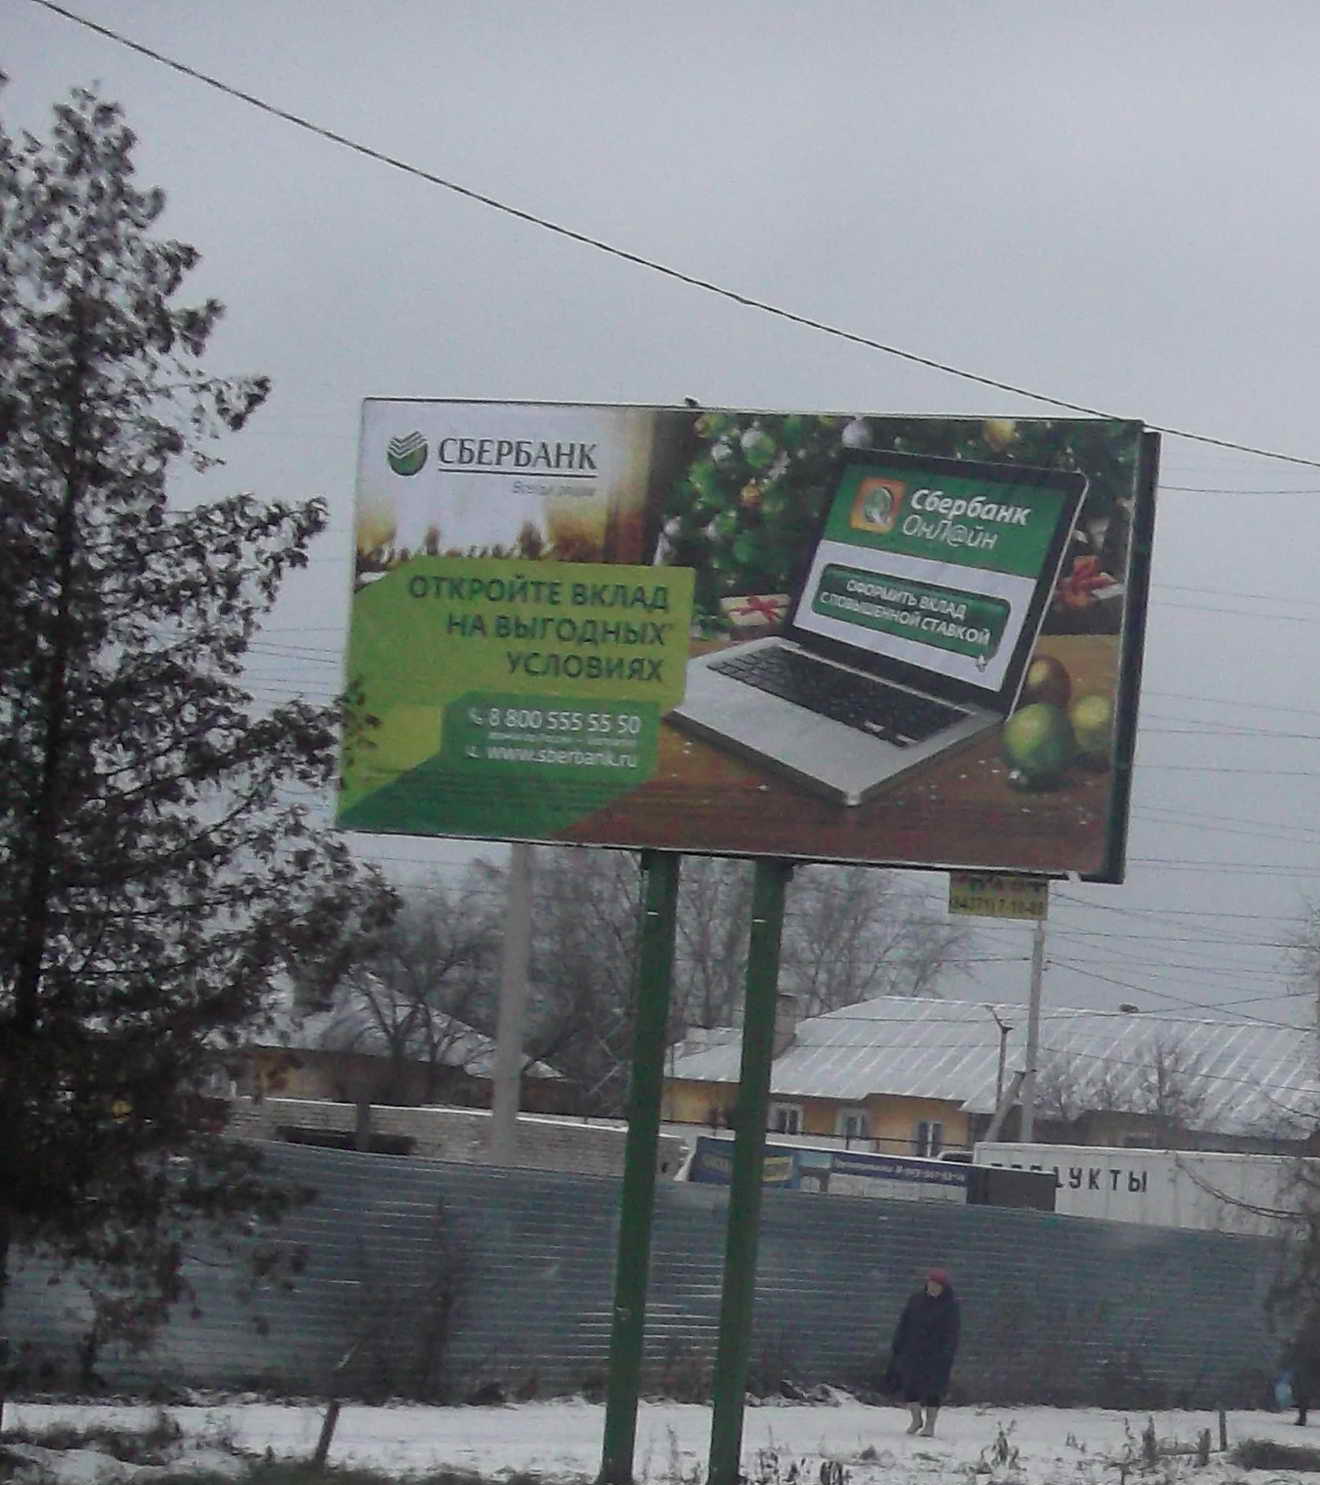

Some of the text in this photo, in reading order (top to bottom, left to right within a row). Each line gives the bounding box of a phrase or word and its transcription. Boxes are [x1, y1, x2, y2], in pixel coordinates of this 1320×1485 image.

[438, 438, 598, 470] СБЕРБАНК
[911, 489, 1032, 525] Сбербанк
[408, 574, 670, 614] ОТКРОЙТЕ ВКЛАД
[918, 595, 968, 621] ВКЛАД
[446, 613, 487, 638] НА
[920, 616, 992, 645] СТАВКОЙ
[506, 652, 665, 682] УСЛОВИЯХ
[488, 707, 641, 734] 8 800 555 55 50
[487, 746, 638, 768] www.sberbank.ru
